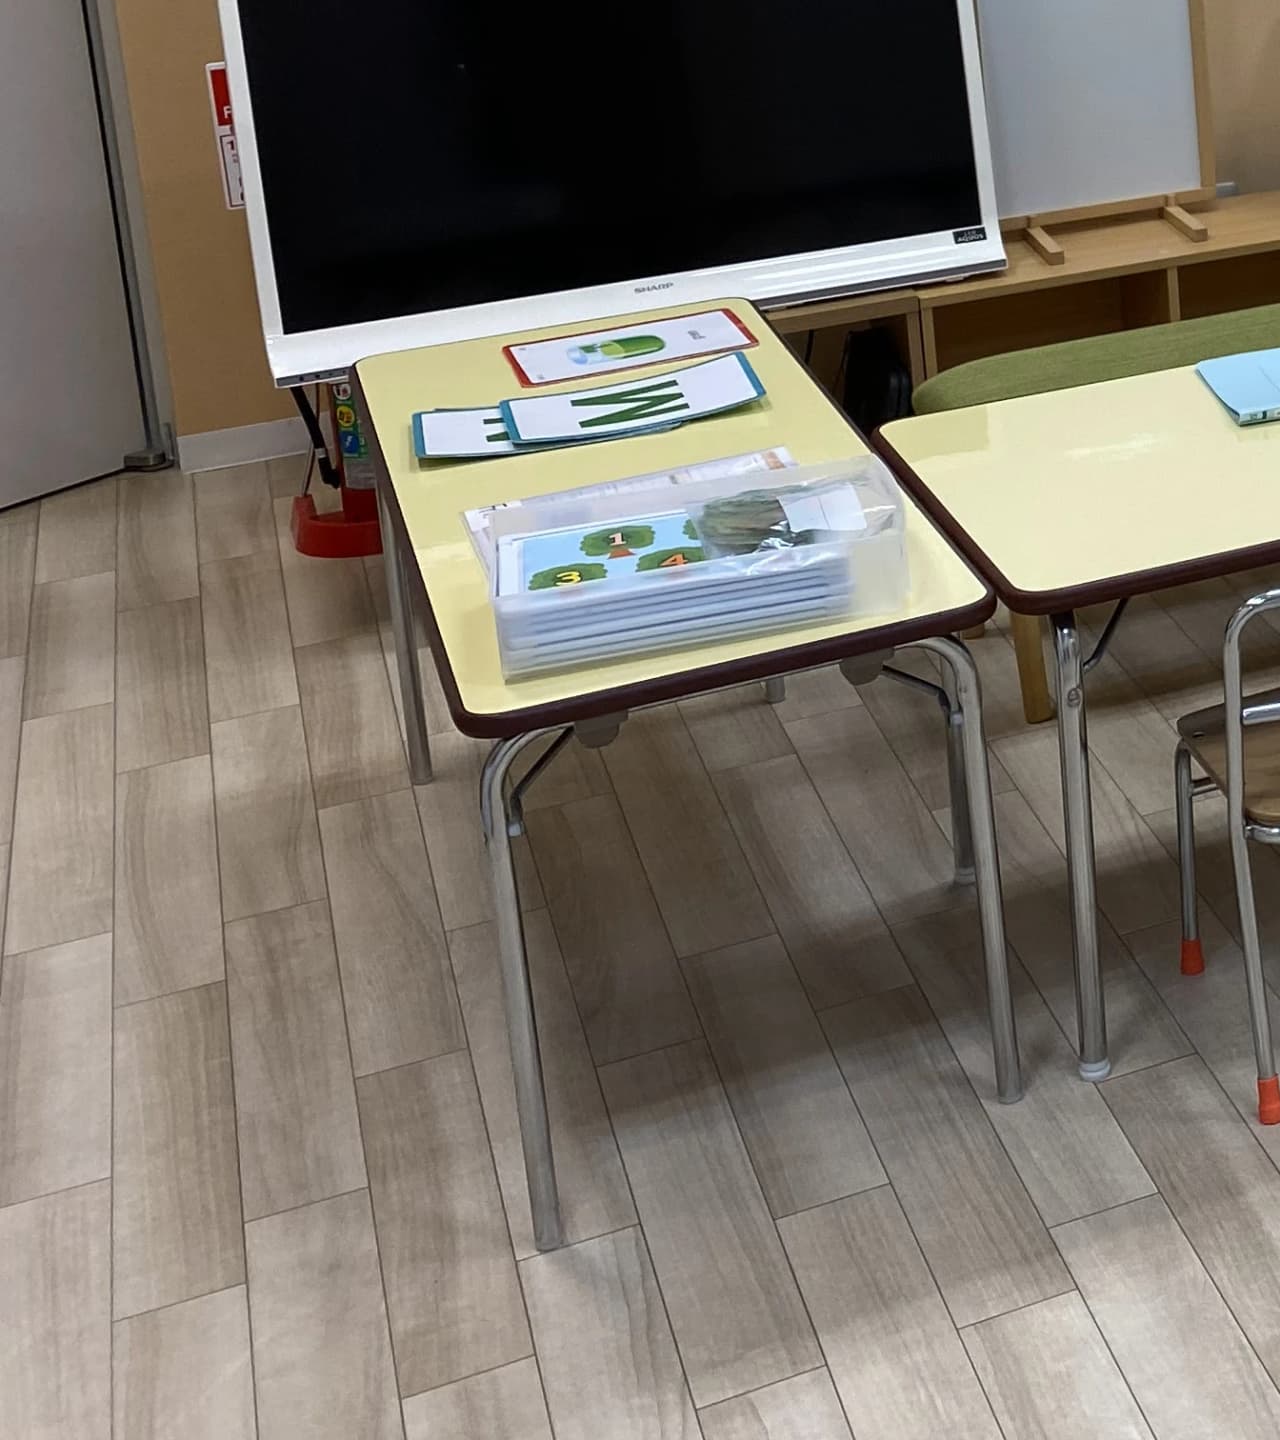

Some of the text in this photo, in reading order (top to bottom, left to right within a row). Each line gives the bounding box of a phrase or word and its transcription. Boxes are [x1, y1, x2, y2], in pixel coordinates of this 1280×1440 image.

[634, 281, 674, 295] SHARP
[608, 531, 627, 547] 1
[659, 552, 689, 567] 4
[554, 570, 583, 586] 3
